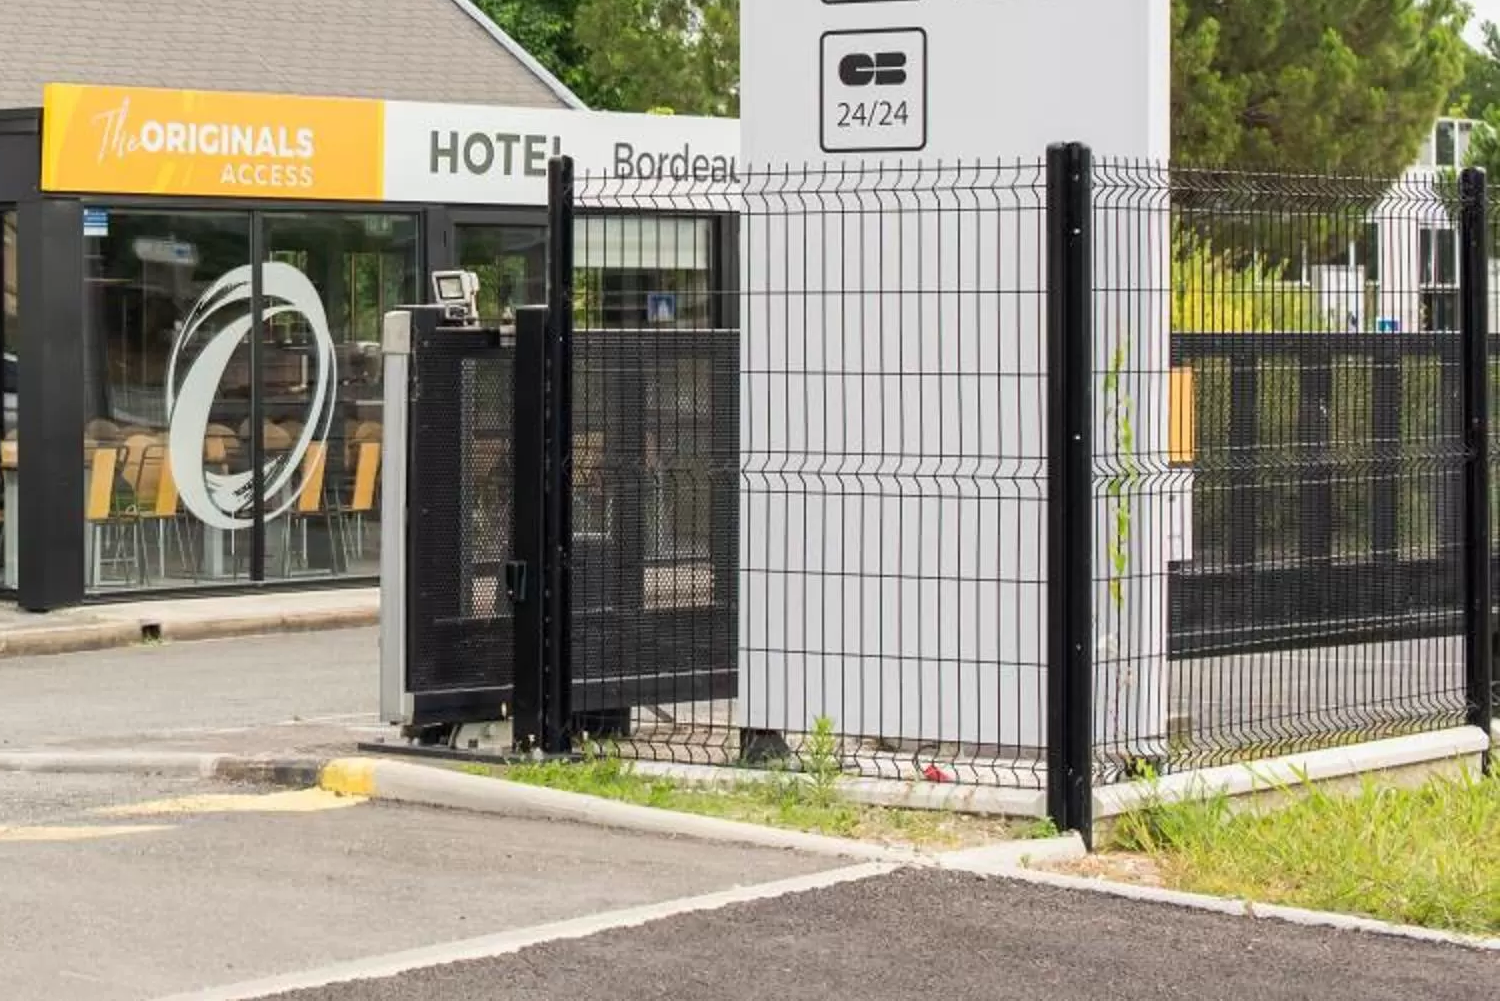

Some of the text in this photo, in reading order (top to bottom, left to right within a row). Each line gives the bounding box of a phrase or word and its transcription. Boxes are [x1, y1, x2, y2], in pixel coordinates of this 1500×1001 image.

[836, 100, 909, 128] 24/24
[140, 120, 315, 159] ORIGINALS
[219, 162, 314, 187] ACCESS
